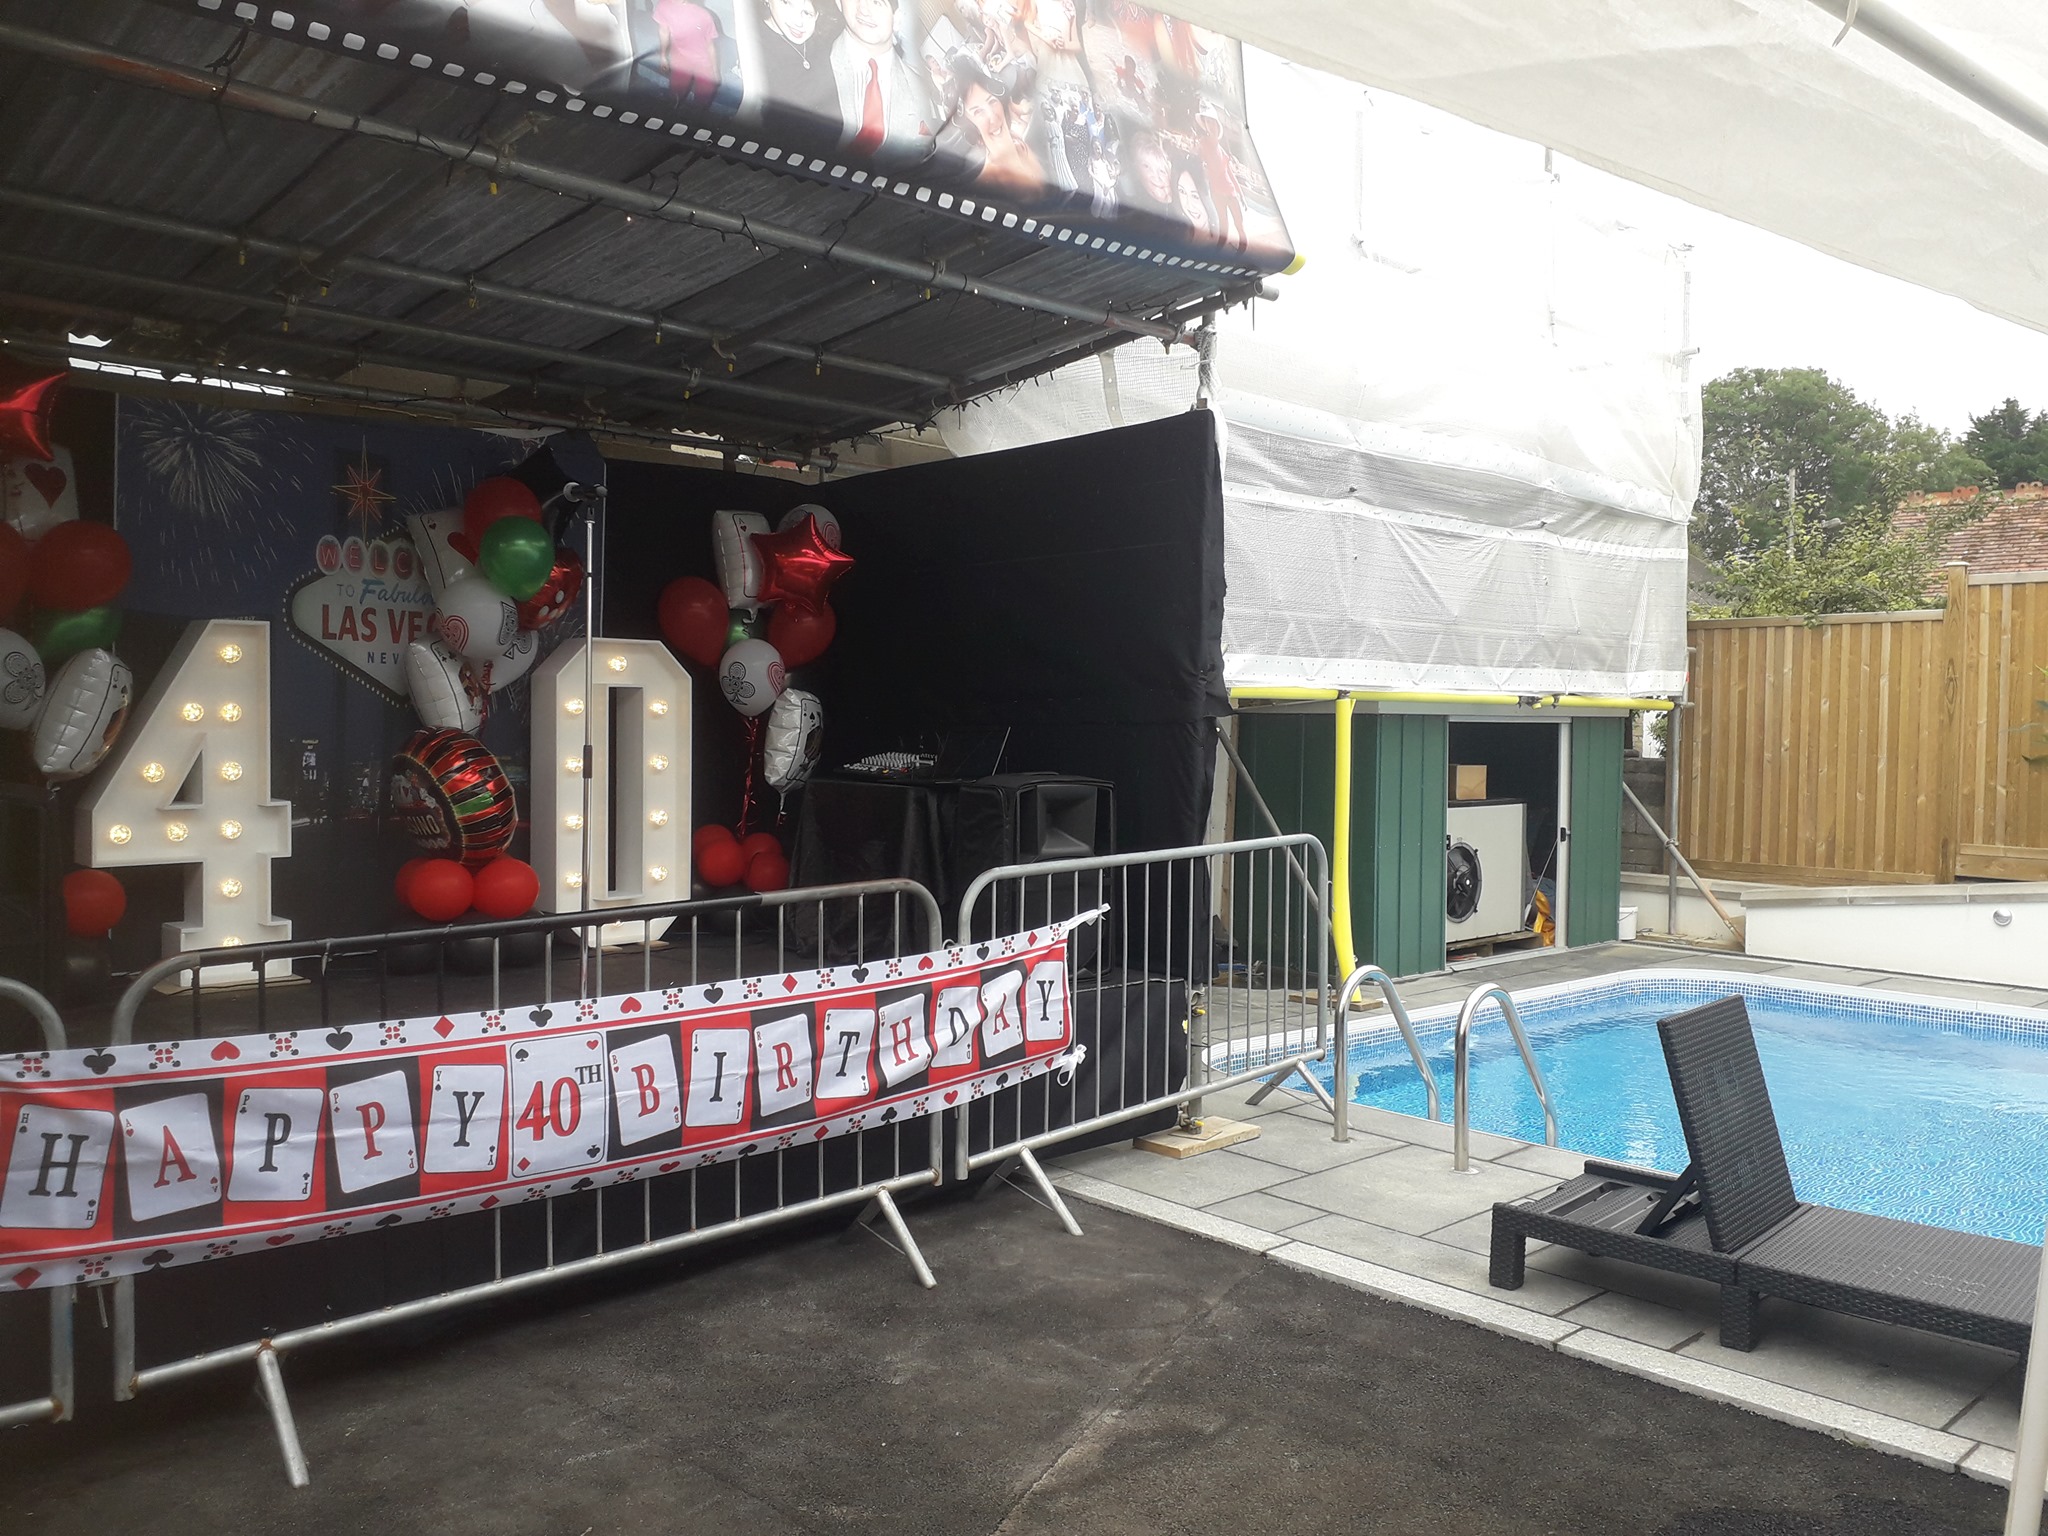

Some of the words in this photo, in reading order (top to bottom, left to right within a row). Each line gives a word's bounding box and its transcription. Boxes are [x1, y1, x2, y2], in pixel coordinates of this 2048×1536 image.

[336, 583, 356, 598] TO
[321, 604, 378, 643] LAS
[367, 651, 400, 665] NEV
[28, 1090, 485, 1198] HAPPY
[631, 980, 1055, 1118] BIRTHDAY
